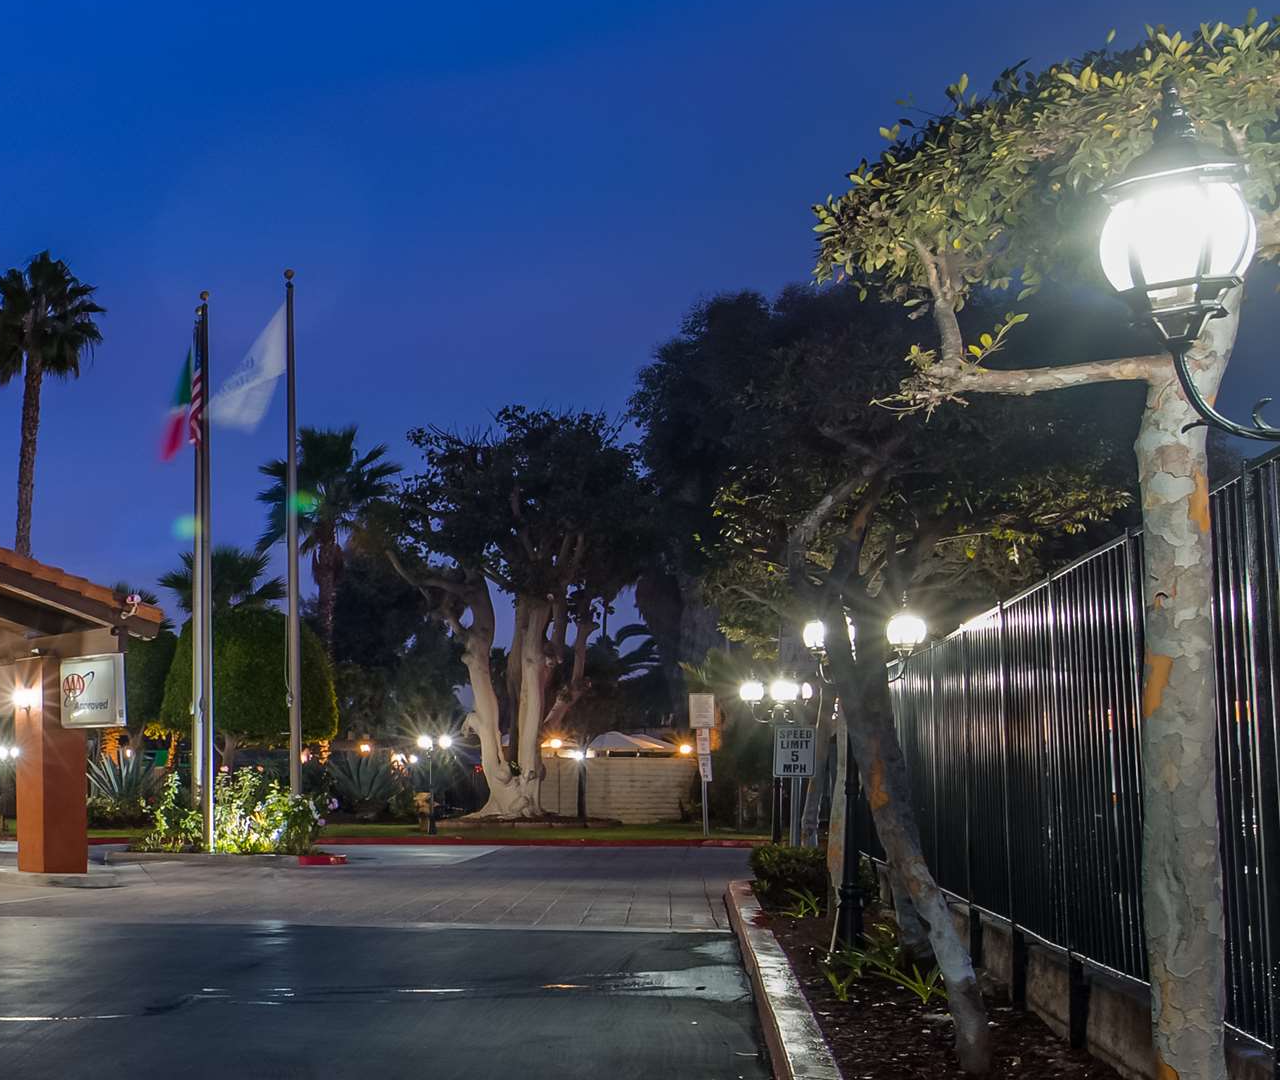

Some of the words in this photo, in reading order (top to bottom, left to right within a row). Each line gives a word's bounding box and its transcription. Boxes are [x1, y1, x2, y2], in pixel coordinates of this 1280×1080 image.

[779, 729, 812, 740] SPEED
[781, 740, 810, 750] LIMIT
[791, 751, 800, 763] 5
[783, 763, 807, 774] MPH
